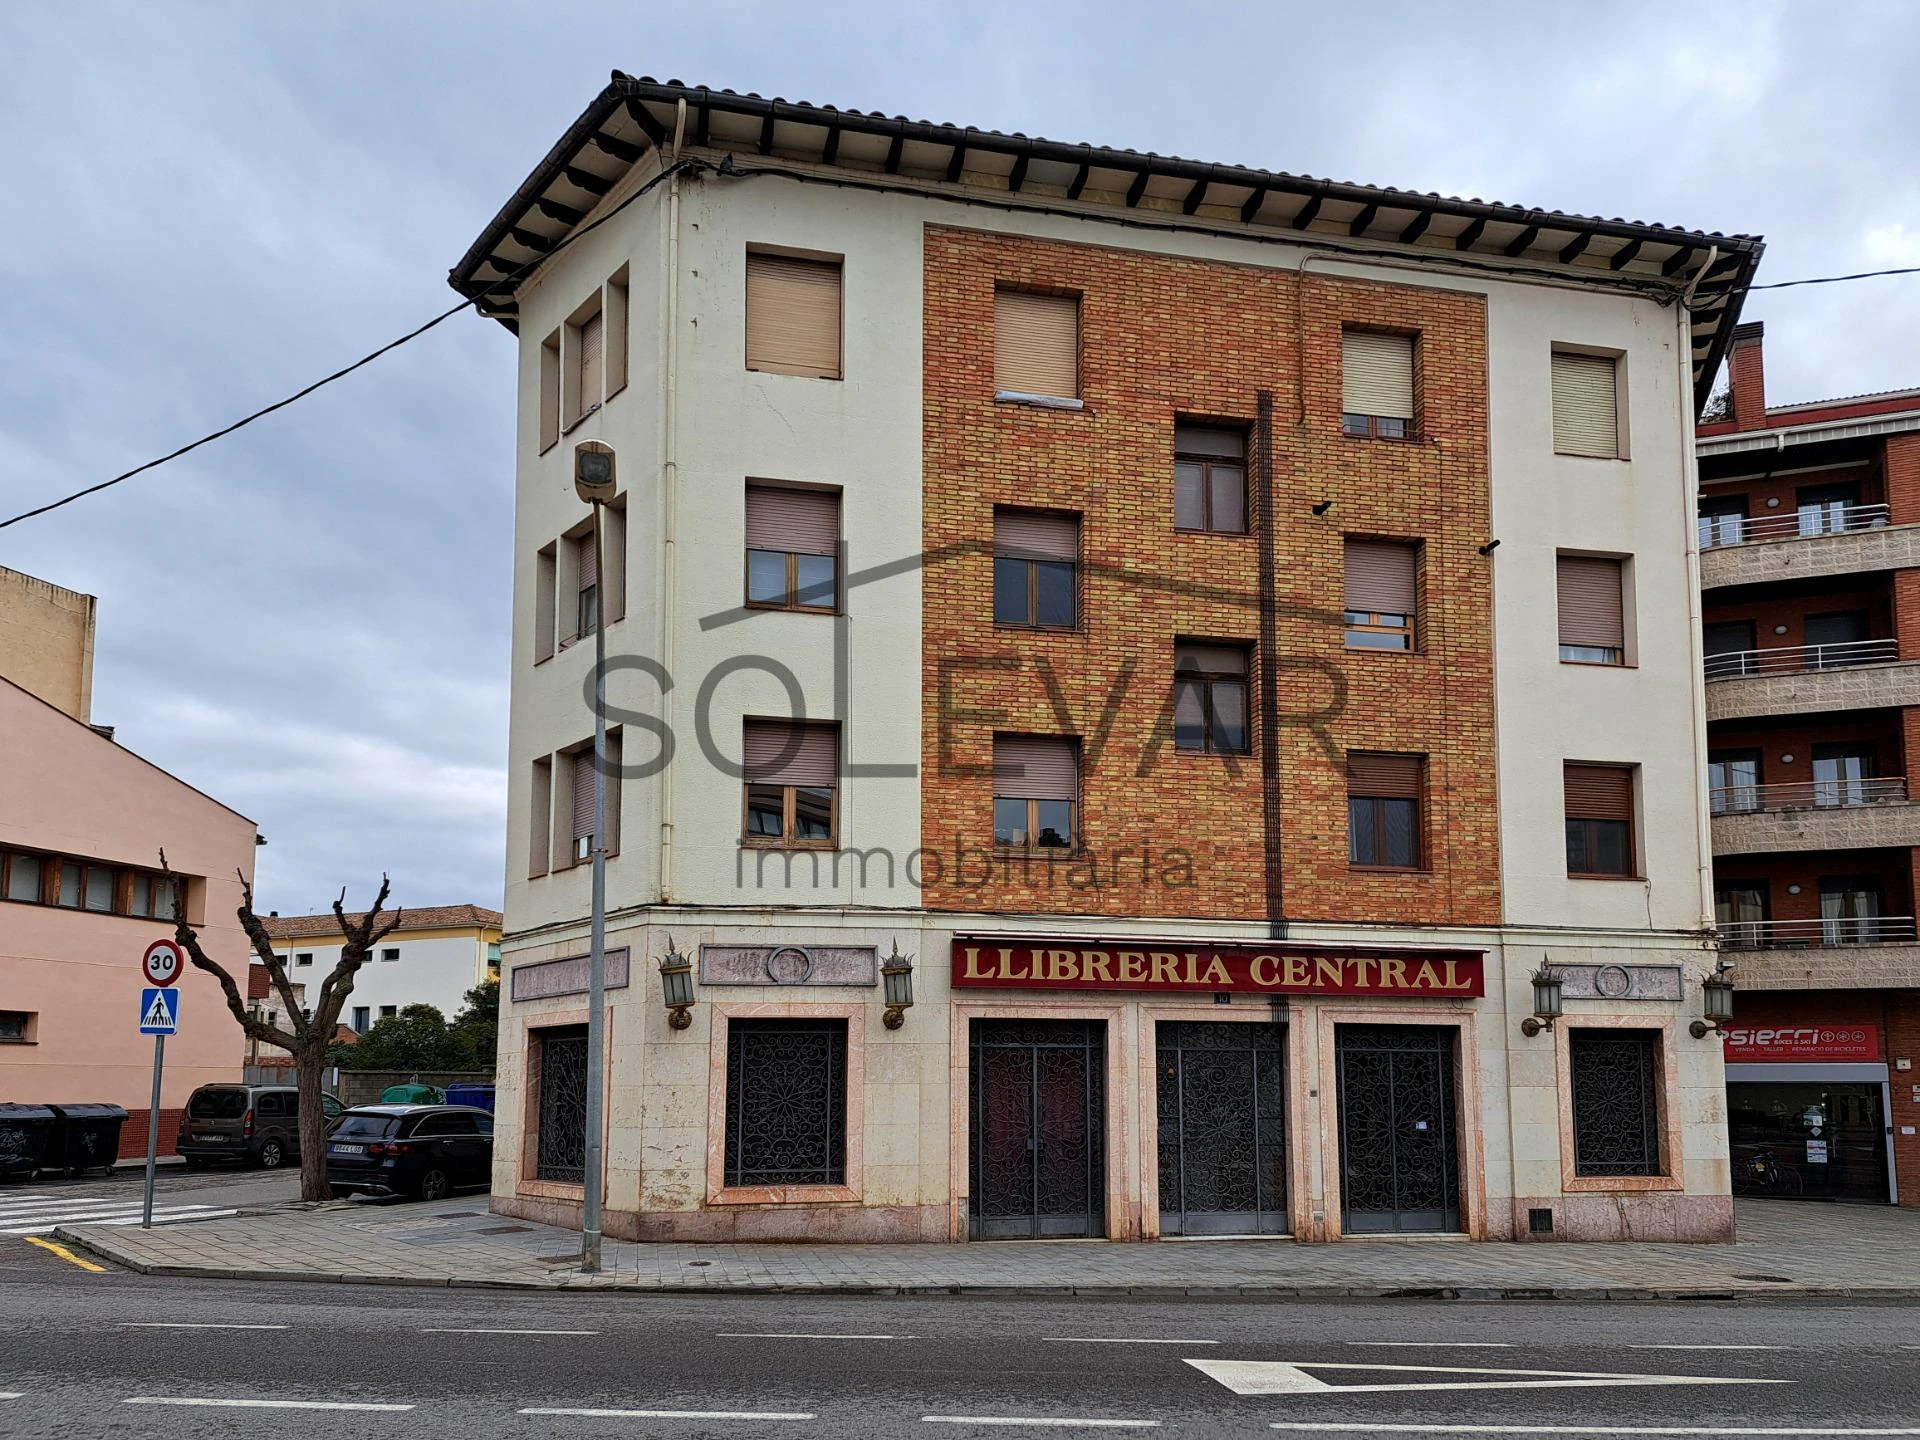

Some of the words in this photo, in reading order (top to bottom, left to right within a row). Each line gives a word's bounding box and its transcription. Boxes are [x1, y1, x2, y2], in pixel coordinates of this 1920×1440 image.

[151, 955, 173, 970] 30
[963, 947, 1234, 985] LLIBRERIA
[1250, 955, 1473, 990] CENTRAL
[1219, 994, 1228, 1003] 10
